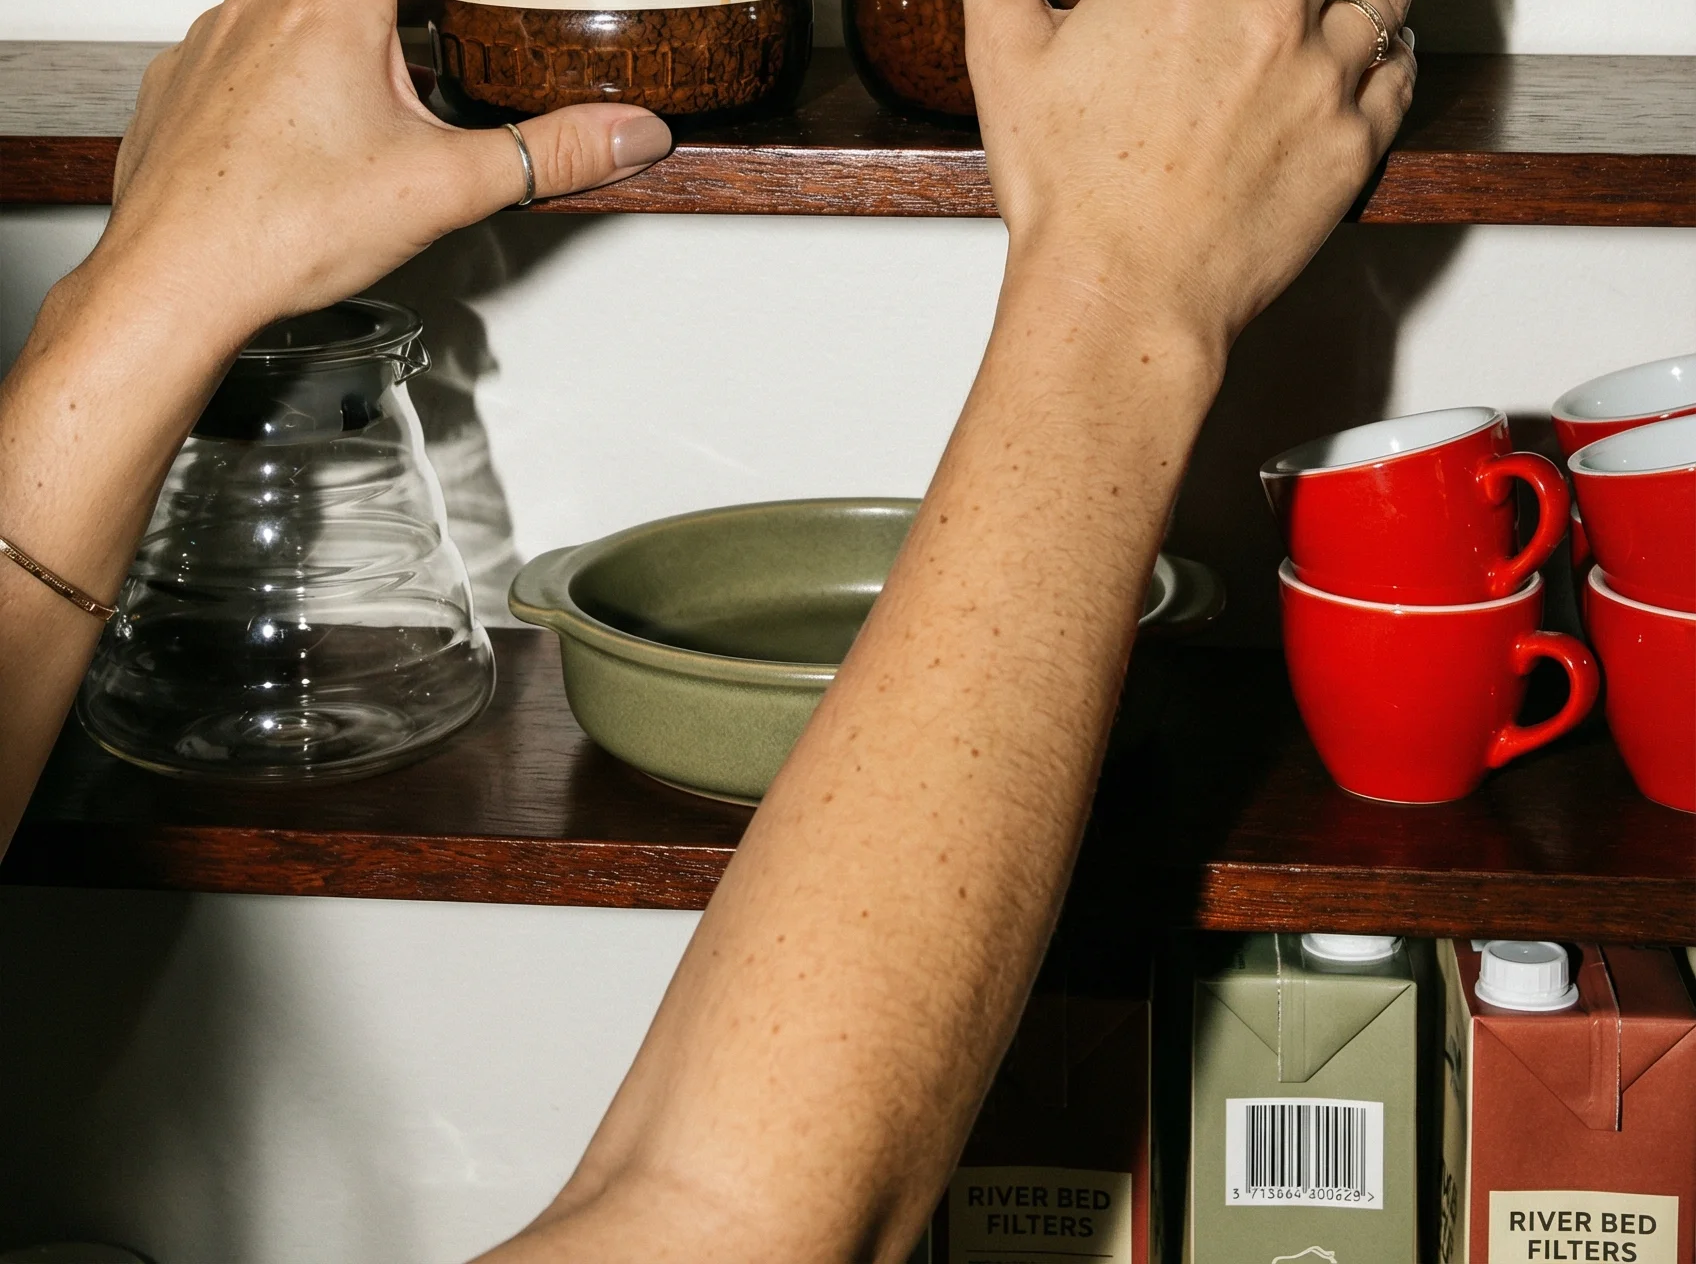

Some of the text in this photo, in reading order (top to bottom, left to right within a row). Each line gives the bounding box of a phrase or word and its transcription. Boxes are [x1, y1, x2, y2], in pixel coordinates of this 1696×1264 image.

[968, 1186, 1111, 1210] RIVER BED
[1233, 1188, 1240, 1199] 3
[987, 1214, 1093, 1238] FILTERS
[1509, 1211, 1657, 1235] RIVER BED
[1528, 1240, 1637, 1262] FILTERS
